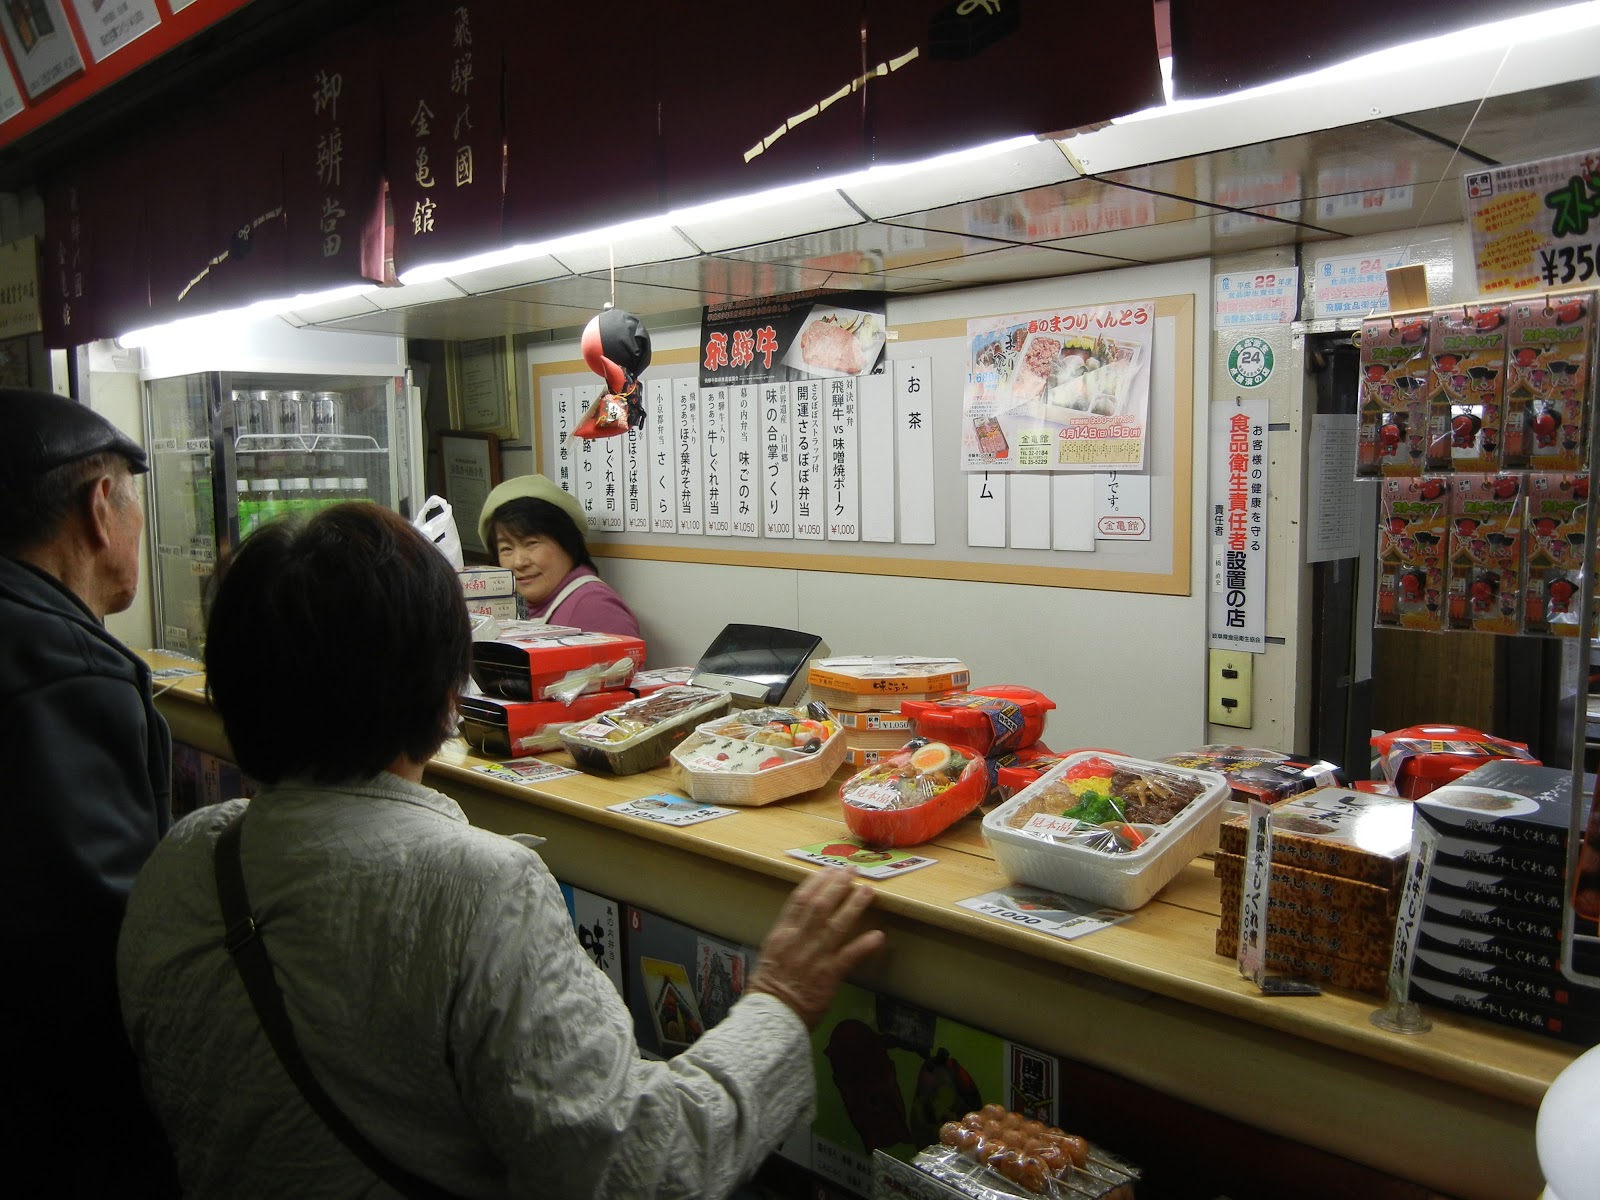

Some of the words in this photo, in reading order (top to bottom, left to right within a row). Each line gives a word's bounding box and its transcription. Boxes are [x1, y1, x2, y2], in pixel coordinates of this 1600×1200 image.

[1360, 259, 1381, 274] 24
[1255, 275, 1275, 288] 22
[704, 325, 778, 371] 飛騨牛
[1242, 351, 1260, 364] 24
[907, 376, 922, 430] お茶
[765, 389, 778, 515] 味の合掌づくり
[797, 386, 810, 517] 開運さるぼぼ弁当
[605, 436, 616, 512] しぐれ寿司
[1251, 425, 1263, 551] お客様の健康を守る
[768, 523, 790, 533] ¥1,000
[1103, 520, 1139, 532] 金亀館
[1214, 504, 1224, 536] 責任者
[831, 524, 855, 535] ¥1,000
[883, 721, 909, 729] ¥1,050
[854, 788, 891, 804] 見本品
[1028, 816, 1073, 832] 見本品
[632, 911, 639, 929] 6
[979, 904, 1042, 925] ¥1000
